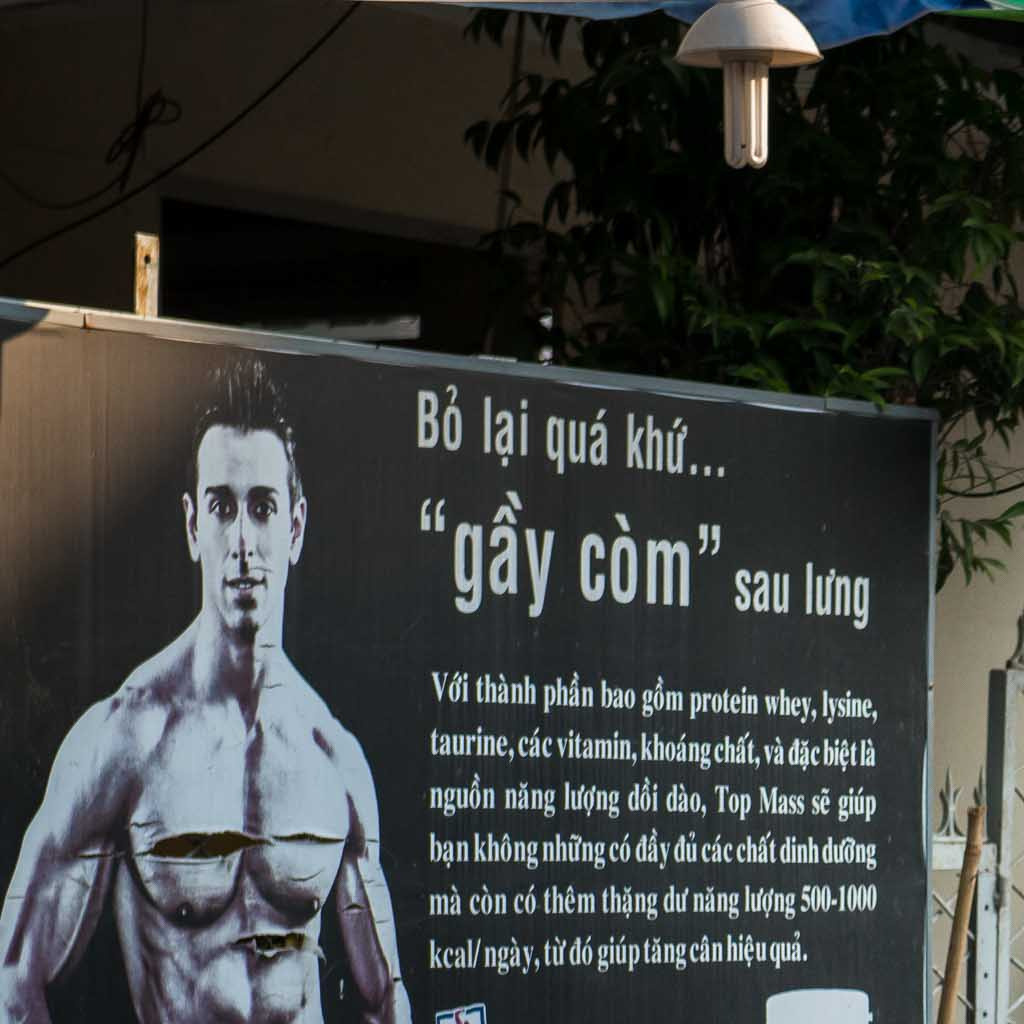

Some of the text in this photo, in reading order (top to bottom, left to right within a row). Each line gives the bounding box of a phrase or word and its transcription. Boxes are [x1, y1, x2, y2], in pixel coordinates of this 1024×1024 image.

[417, 384, 726, 478] Bỏ lại quá khứ...
[420, 491, 870, 630] “gầy còm” sau lưng
[431, 671, 878, 724] Với thành phần bao gồm protein whey, lysine,
[430, 726, 876, 772] taurine, các vitamin, khoáng chất, và đặc biệt là
[430, 772, 877, 821] nguồn năng lượng dồi dào, Top Mass sẽ giúp
[429, 828, 877, 870] bạn không những có đầy đủ các chất dinh dưỡng
[429, 883, 878, 920] mà còn có thêm thặng dư năng lượng 500-1000
[544, 936, 567, 966] từ
[569, 935, 593, 966] đó
[598, 934, 640, 973] giúp
[644, 937, 687, 971] tăng
[690, 934, 723, 963] cân
[727, 933, 767, 968] hiệu
[770, 930, 808, 969] quả.
